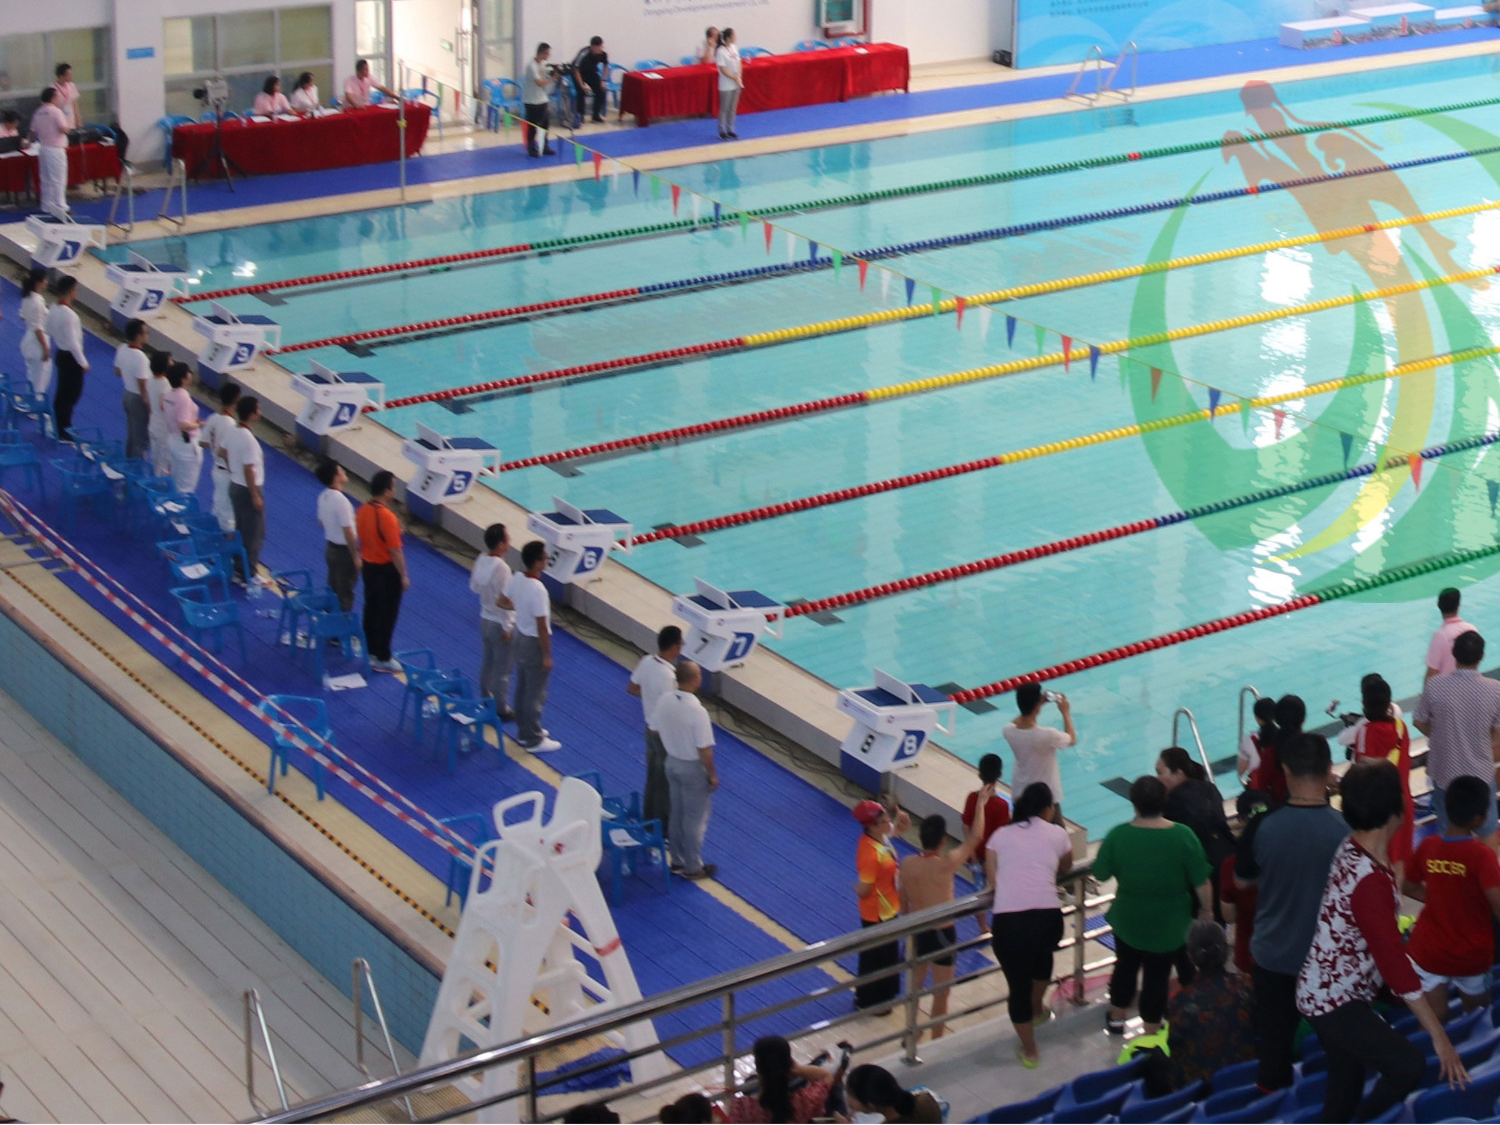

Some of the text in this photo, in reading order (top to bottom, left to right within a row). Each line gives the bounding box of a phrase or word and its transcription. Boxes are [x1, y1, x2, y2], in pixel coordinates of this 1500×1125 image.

[146, 291, 159, 308] 2
[237, 345, 250, 363] 3
[338, 405, 350, 422] 4
[452, 473, 467, 492] 5
[583, 550, 597, 570] 6
[734, 635, 748, 656] 7
[860, 733, 876, 755] 8
[903, 734, 917, 756] 8
